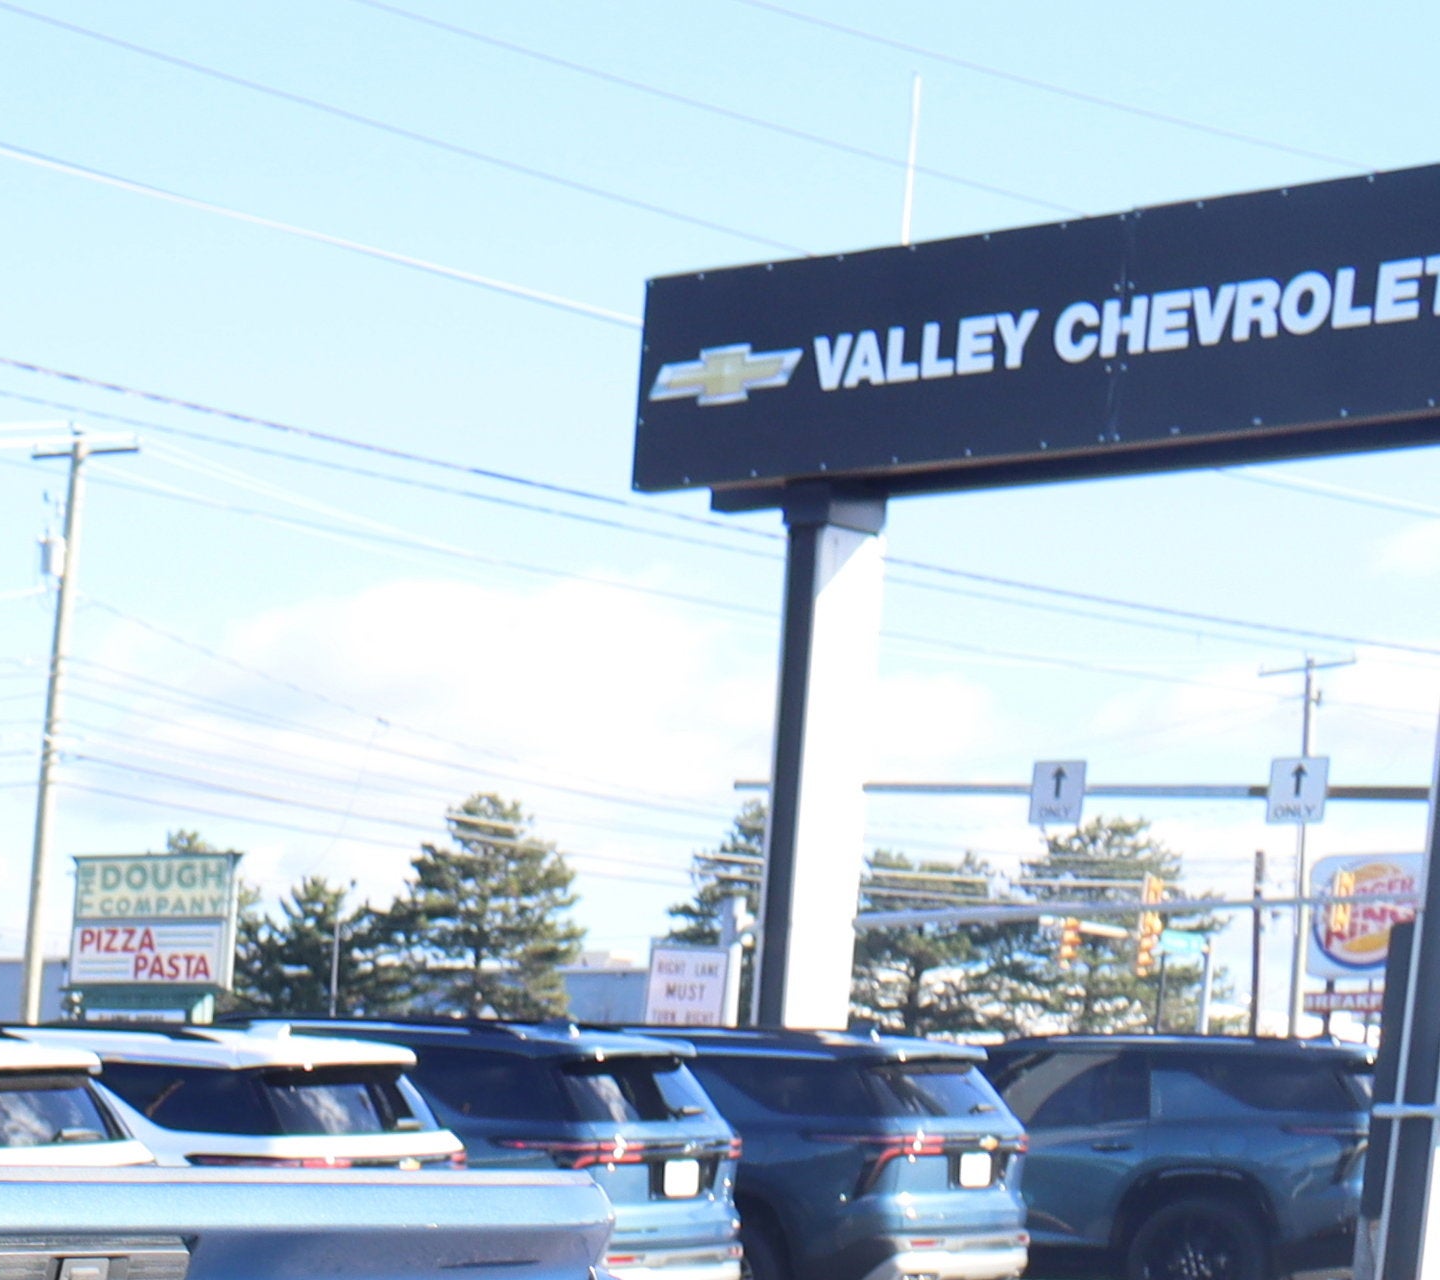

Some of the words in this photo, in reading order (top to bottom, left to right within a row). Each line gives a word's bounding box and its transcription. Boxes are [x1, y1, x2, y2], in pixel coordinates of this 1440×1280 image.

[813, 309, 1040, 391] VALLEY
[1038, 804, 1073, 819] ONLY
[1274, 804, 1317, 819] ONLY
[80, 865, 96, 914] THE
[101, 862, 224, 891] DOUGH
[100, 897, 223, 916] COMPANY
[80, 927, 155, 954] PIZZA
[133, 953, 211, 980] PASTA
[664, 981, 707, 1002] MUST
